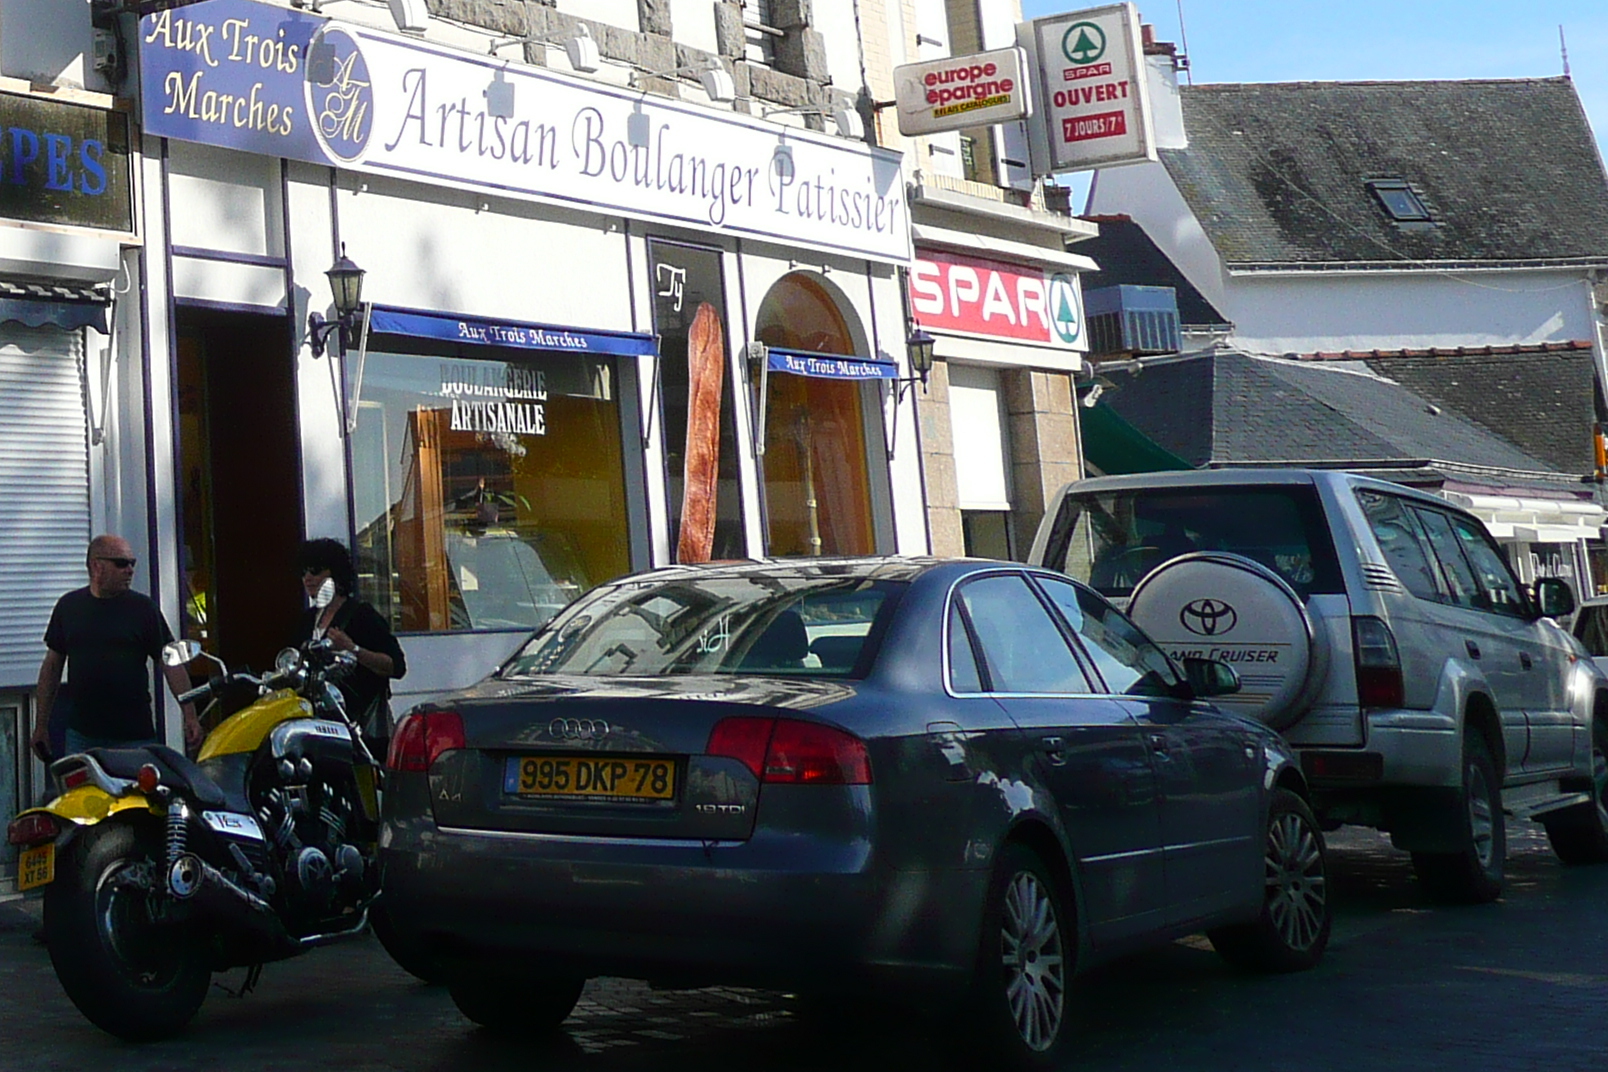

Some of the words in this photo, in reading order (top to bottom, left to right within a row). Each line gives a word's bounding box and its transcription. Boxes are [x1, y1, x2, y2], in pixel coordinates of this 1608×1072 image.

[145, 9, 219, 67] Aux
[222, 18, 299, 74] Trois
[924, 63, 997, 87] europe
[1064, 64, 1110, 79] SPAR
[163, 71, 294, 136] Marches
[1053, 80, 1128, 108] OUVERT
[1064, 123, 1071, 137] 7
[384, 67, 560, 171] Artisan
[571, 106, 760, 224] Boulanger
[768, 150, 899, 235] Patissier
[910, 259, 1049, 330] SPAR
[458, 322, 491, 344] Aux
[490, 326, 526, 344] Trois
[528, 330, 588, 348] Marches
[785, 355, 807, 375] Aux
[808, 358, 835, 374] Trois
[837, 361, 882, 376] Marches
[440, 364, 547, 400] BOULANGERIE
[450, 399, 545, 435] ARTISANALE
[1208, 648, 1279, 663] CRUISER
[521, 760, 571, 791] 995
[575, 761, 628, 792] DKP
[634, 763, 669, 794] 78
[717, 805, 745, 814] TDI
